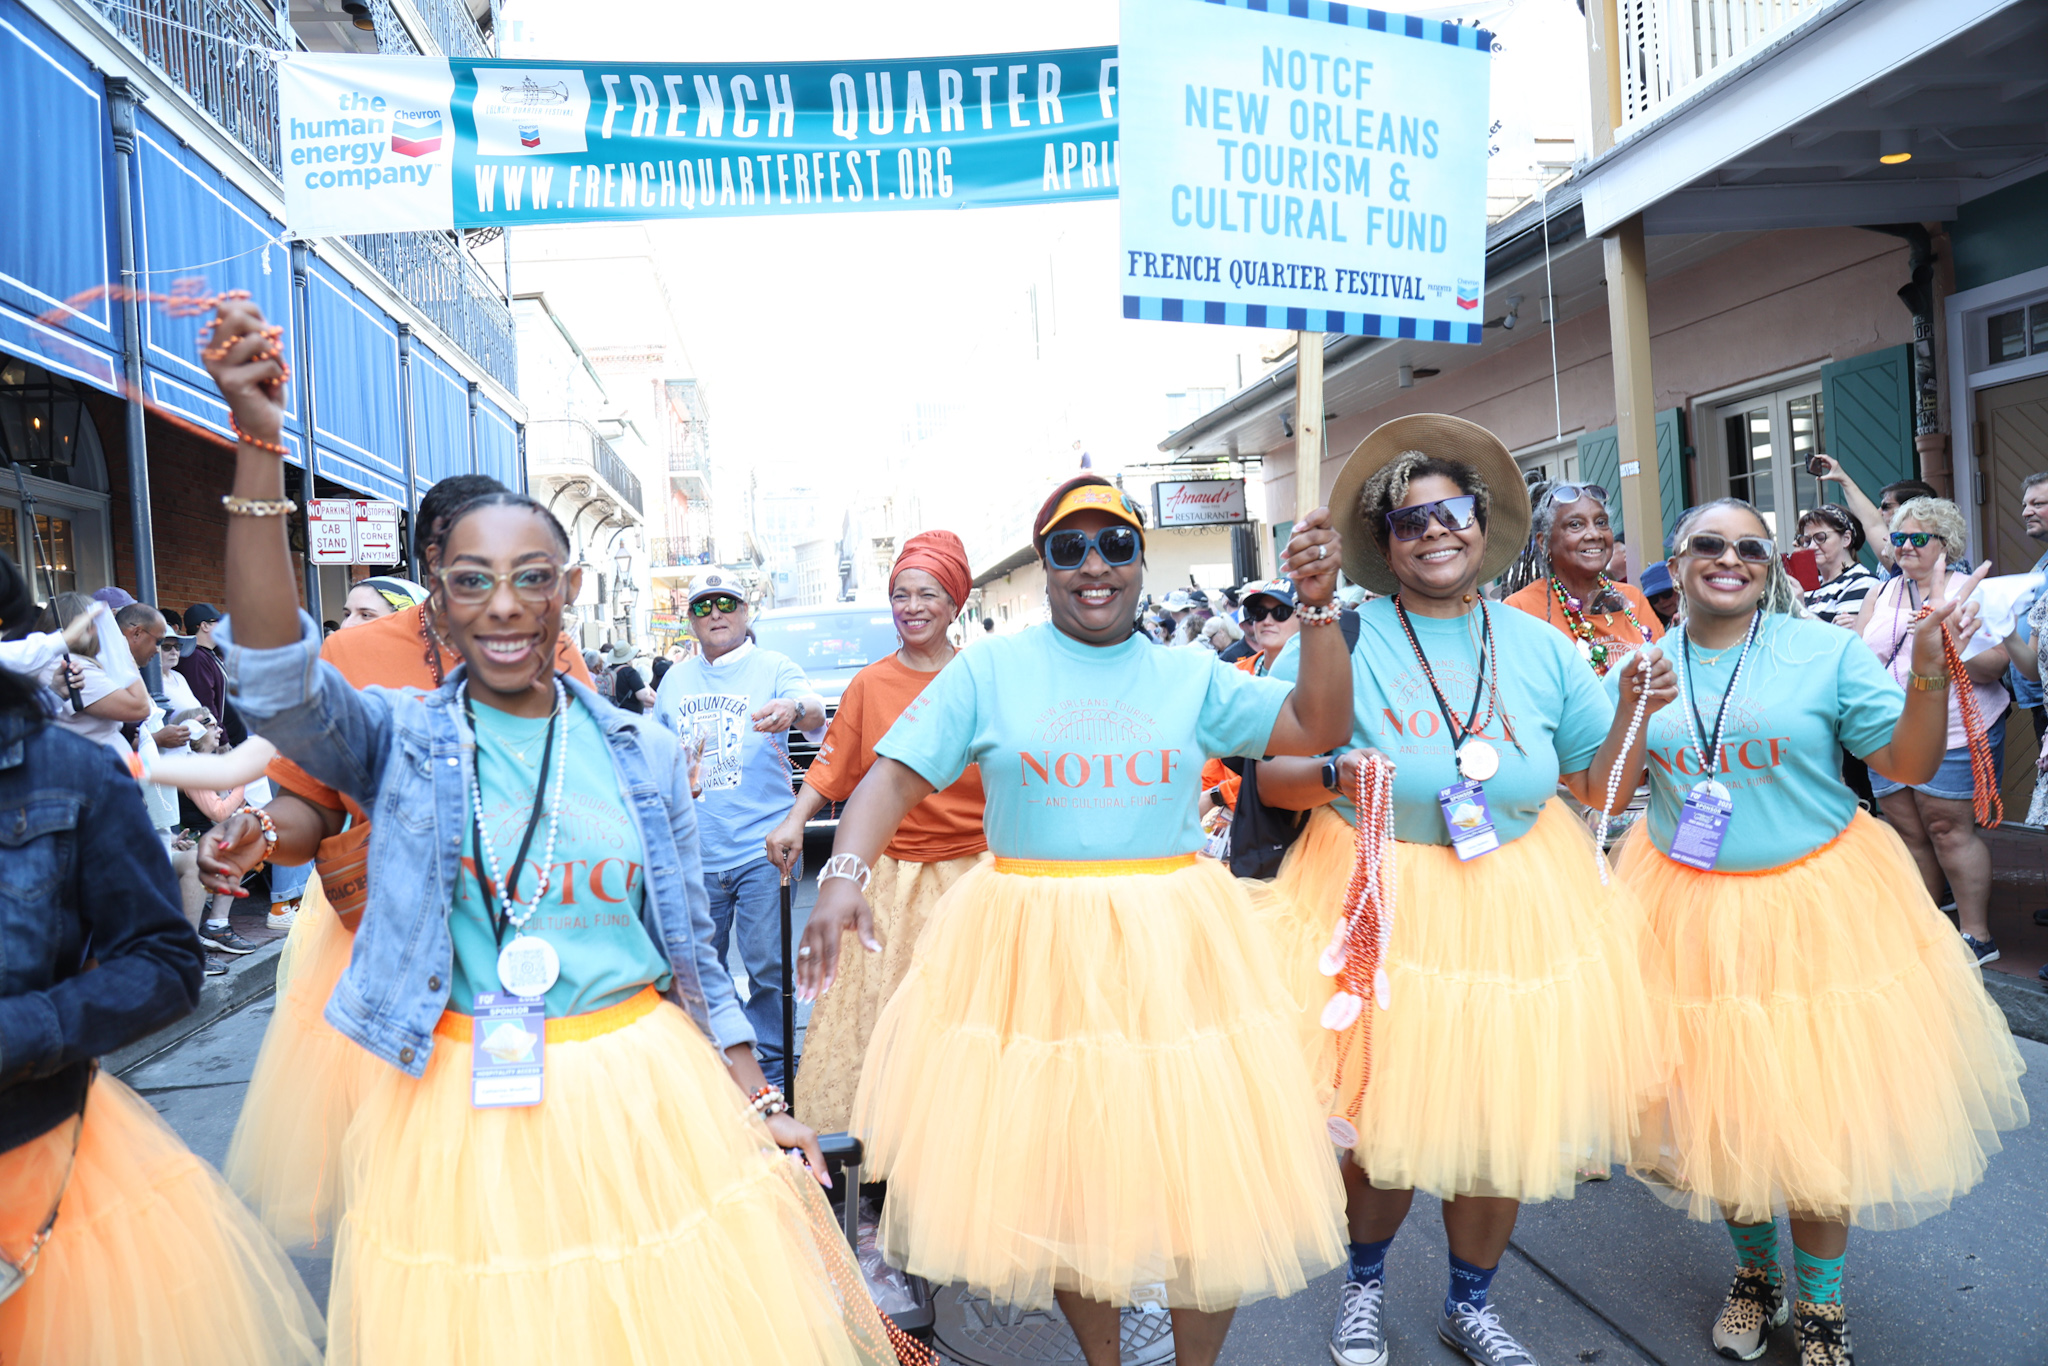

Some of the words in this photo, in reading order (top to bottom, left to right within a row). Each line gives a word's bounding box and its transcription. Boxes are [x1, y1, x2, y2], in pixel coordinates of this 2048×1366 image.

[1262, 45, 1374, 100] NOTCF
[338, 92, 387, 113] the
[600, 74, 795, 138] FRENCH
[830, 62, 1064, 140] QUARTER
[393, 108, 441, 121] Chevron
[545, 108, 574, 117] FESTIVAL
[1185, 84, 1270, 136] NEW
[1290, 98, 1440, 159] ORLEANS
[290, 118, 385, 141] human
[290, 140, 385, 165] energy
[1043, 140, 1119, 191] APRI
[1217, 138, 1371, 198] TOURISM
[1389, 162, 1411, 202] &
[305, 163, 433, 190] company
[474, 146, 954, 212] WWW.FRENCHQUARTERFEST.ORG
[1171, 184, 1347, 243] CULTURAL
[1367, 206, 1447, 254] FUND
[1128, 250, 1222, 283] FRENCH
[1229, 259, 1328, 291] QUARTER
[1335, 268, 1426, 301] FESTIVAL
[1457, 278, 1480, 286] Chevron
[1166, 482, 1238, 513] Arnaud's
[308, 504, 321, 518] NO
[322, 506, 350, 515] PARKING
[355, 504, 367, 518] NO
[367, 507, 395, 516] STOPPING
[1175, 511, 1231, 521] RESTAURANT
[321, 524, 341, 534] CAB
[360, 532, 394, 540] CORNER
[372, 523, 382, 531] TO
[317, 538, 348, 548] STAND
[361, 552, 396, 560] ANYTIME
[1389, 671, 1408, 689] NEW
[1409, 660, 1455, 673] OREANS
[679, 696, 747, 717] VOLUNTEER
[1035, 708, 1057, 725] NEW
[1059, 698, 1109, 710] ORLEANS
[1114, 699, 1156, 726] TOURISM
[1399, 745, 1419, 755] AND
[1647, 736, 1791, 777] NOTCF
[1017, 749, 1181, 788] NOTCF
[1747, 775, 1773, 786] FUND
[572, 792, 628, 826] TOURISM
[1046, 797, 1067, 808] AND
[1072, 797, 1126, 809] CULTURAL
[1131, 795, 1158, 806] FUND
[523, 916, 589, 931] CULTURAL
[594, 914, 630, 927] FUND
[490, 1006, 529, 1016] SPONSOR
